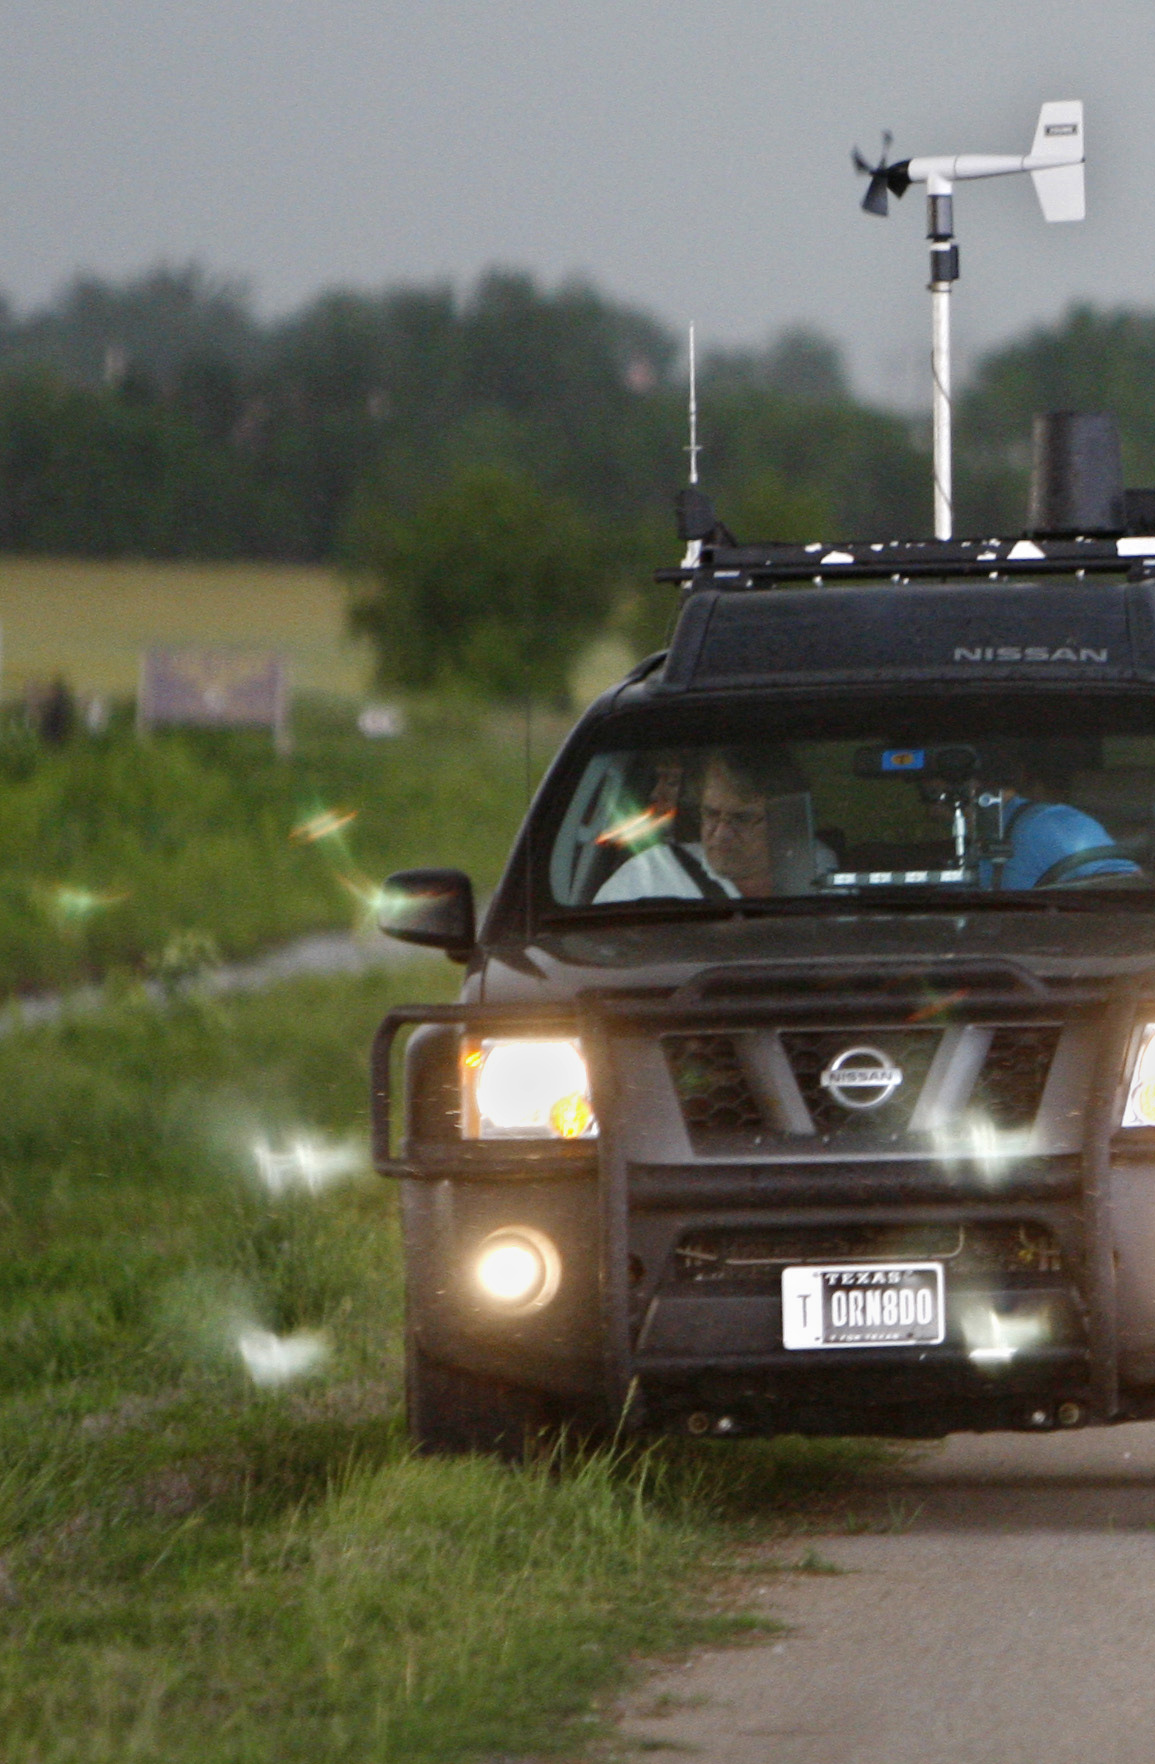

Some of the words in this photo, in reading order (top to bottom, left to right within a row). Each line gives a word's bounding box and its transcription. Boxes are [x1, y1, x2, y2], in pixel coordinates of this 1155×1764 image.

[954, 647, 1108, 662] NISSAN
[829, 1070, 892, 1082] NISSAN
[825, 1271, 900, 1286] TEXAS
[797, 1294, 811, 1329] T
